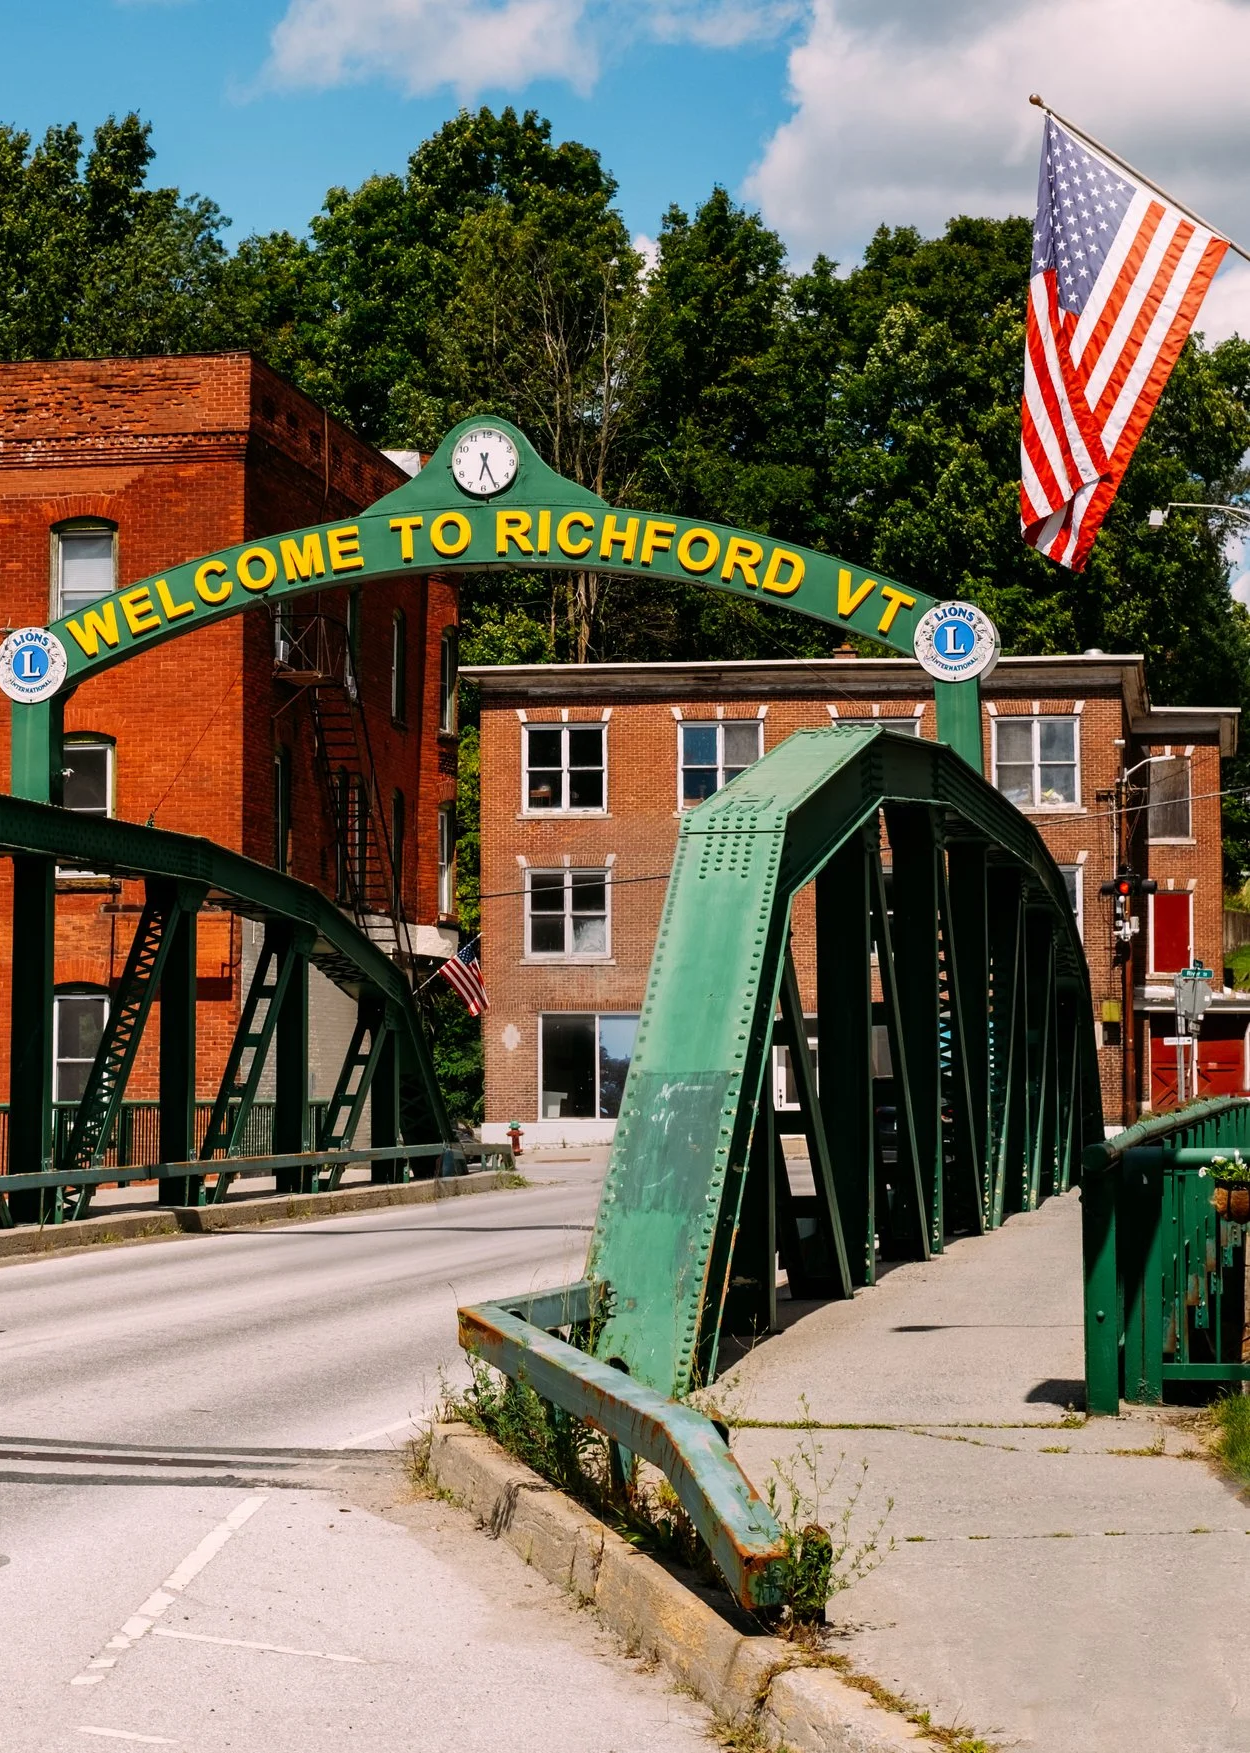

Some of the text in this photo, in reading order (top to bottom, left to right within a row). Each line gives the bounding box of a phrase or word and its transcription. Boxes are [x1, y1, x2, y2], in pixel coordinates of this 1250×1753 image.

[482, 431, 493, 439] 12
[498, 435, 502, 443] 1
[494, 481, 500, 489] 5
[65, 509, 918, 656] WELCOME TO RICHFORD VT
[934, 606, 975, 622] LIONS
[13, 632, 50, 647] LIONS
[943, 626, 966, 654] L
[21, 650, 41, 678] L
[931, 656, 979, 672] INTERNATIONAL
[10, 679, 52, 693] INTERNATIONAL
